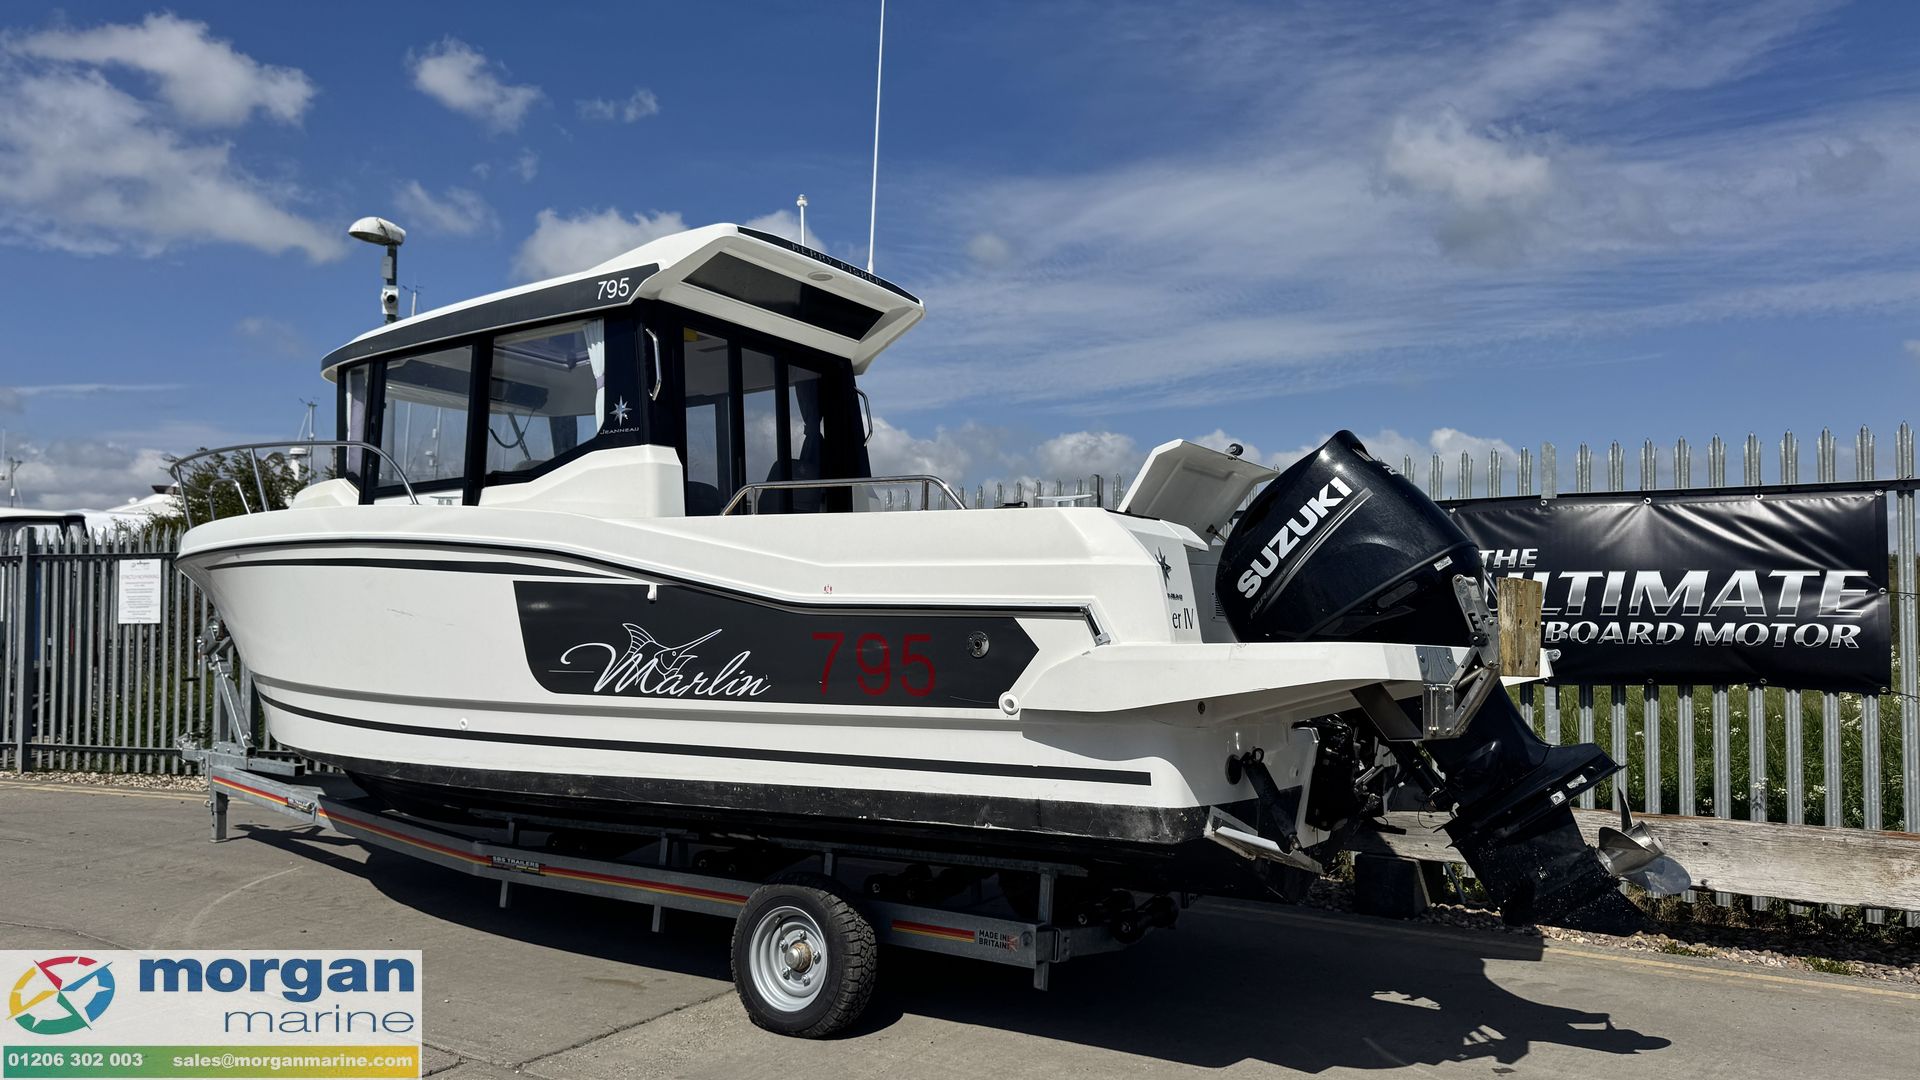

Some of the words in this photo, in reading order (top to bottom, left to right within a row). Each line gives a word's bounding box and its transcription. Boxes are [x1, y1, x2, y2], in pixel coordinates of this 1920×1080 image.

[597, 277, 630, 300] 795
[600, 427, 640, 435] JEANNEAU
[1237, 476, 1353, 599] SUZUKI
[1479, 548, 1539, 569] THE
[1693, 621, 1863, 649] MOTOR
[560, 641, 772, 698] Marlin
[812, 632, 937, 698] 795
[979, 929, 999, 940] MADE
[1000, 934, 1007, 942] IN
[979, 937, 1007, 950] BRITAIN
